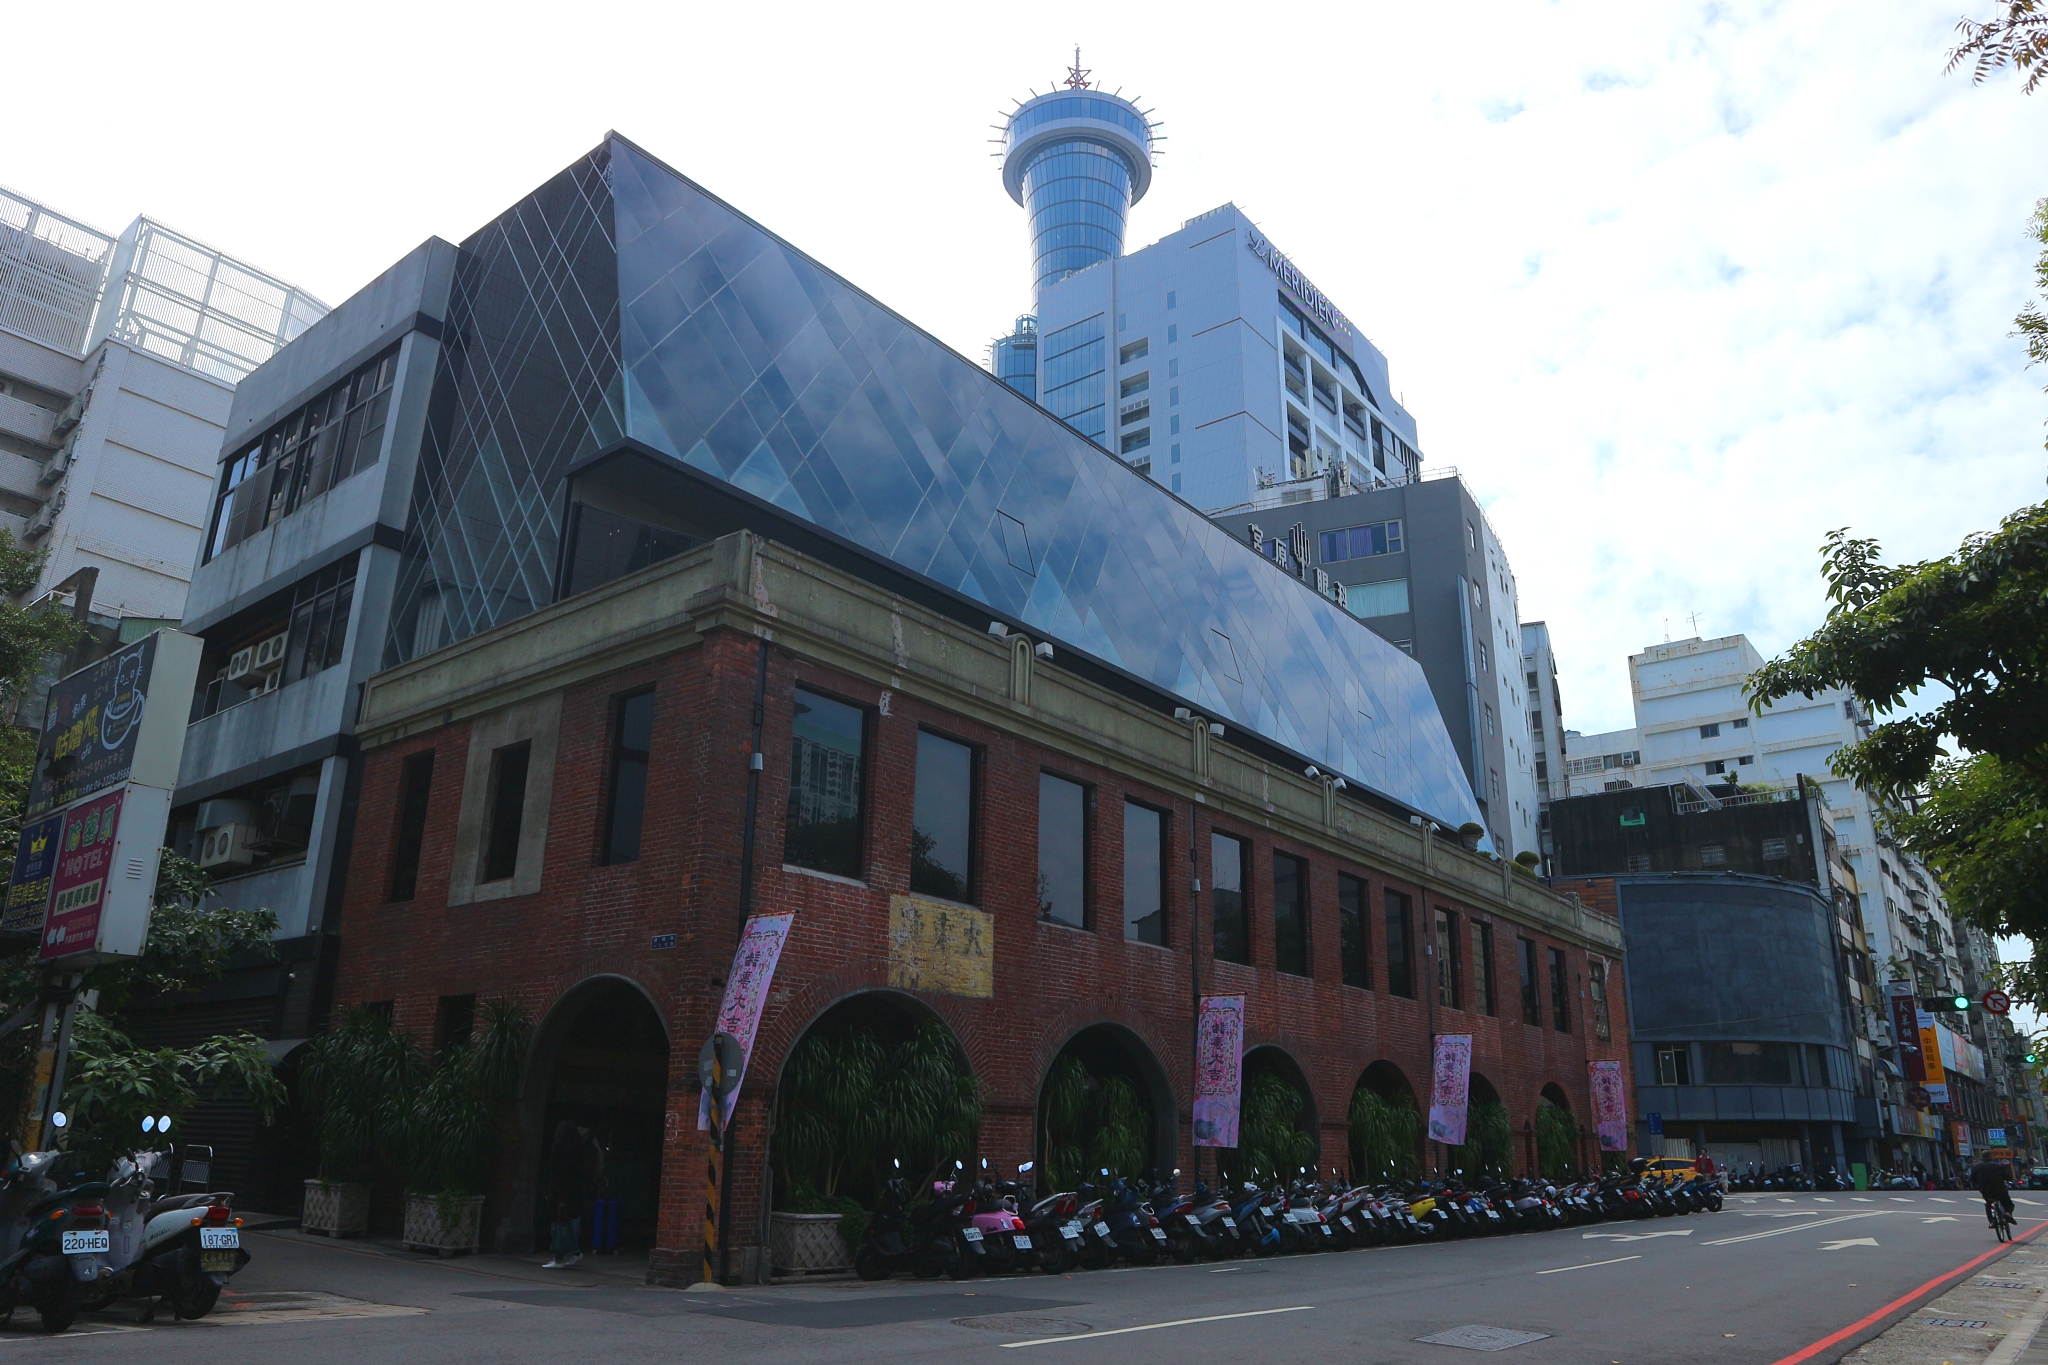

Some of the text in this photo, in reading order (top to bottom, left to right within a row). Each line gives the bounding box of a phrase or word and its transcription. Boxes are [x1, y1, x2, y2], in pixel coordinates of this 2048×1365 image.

[1248, 230, 1335, 331] Le MERIDIEN
[65, 803, 116, 853] 哈密瓜
[64, 847, 104, 878] HOTEL
[1923, 1038, 1936, 1070] 中租租車
[64, 1237, 108, 1251] 220-HEQ
[202, 1234, 238, 1246] 187-GRX
